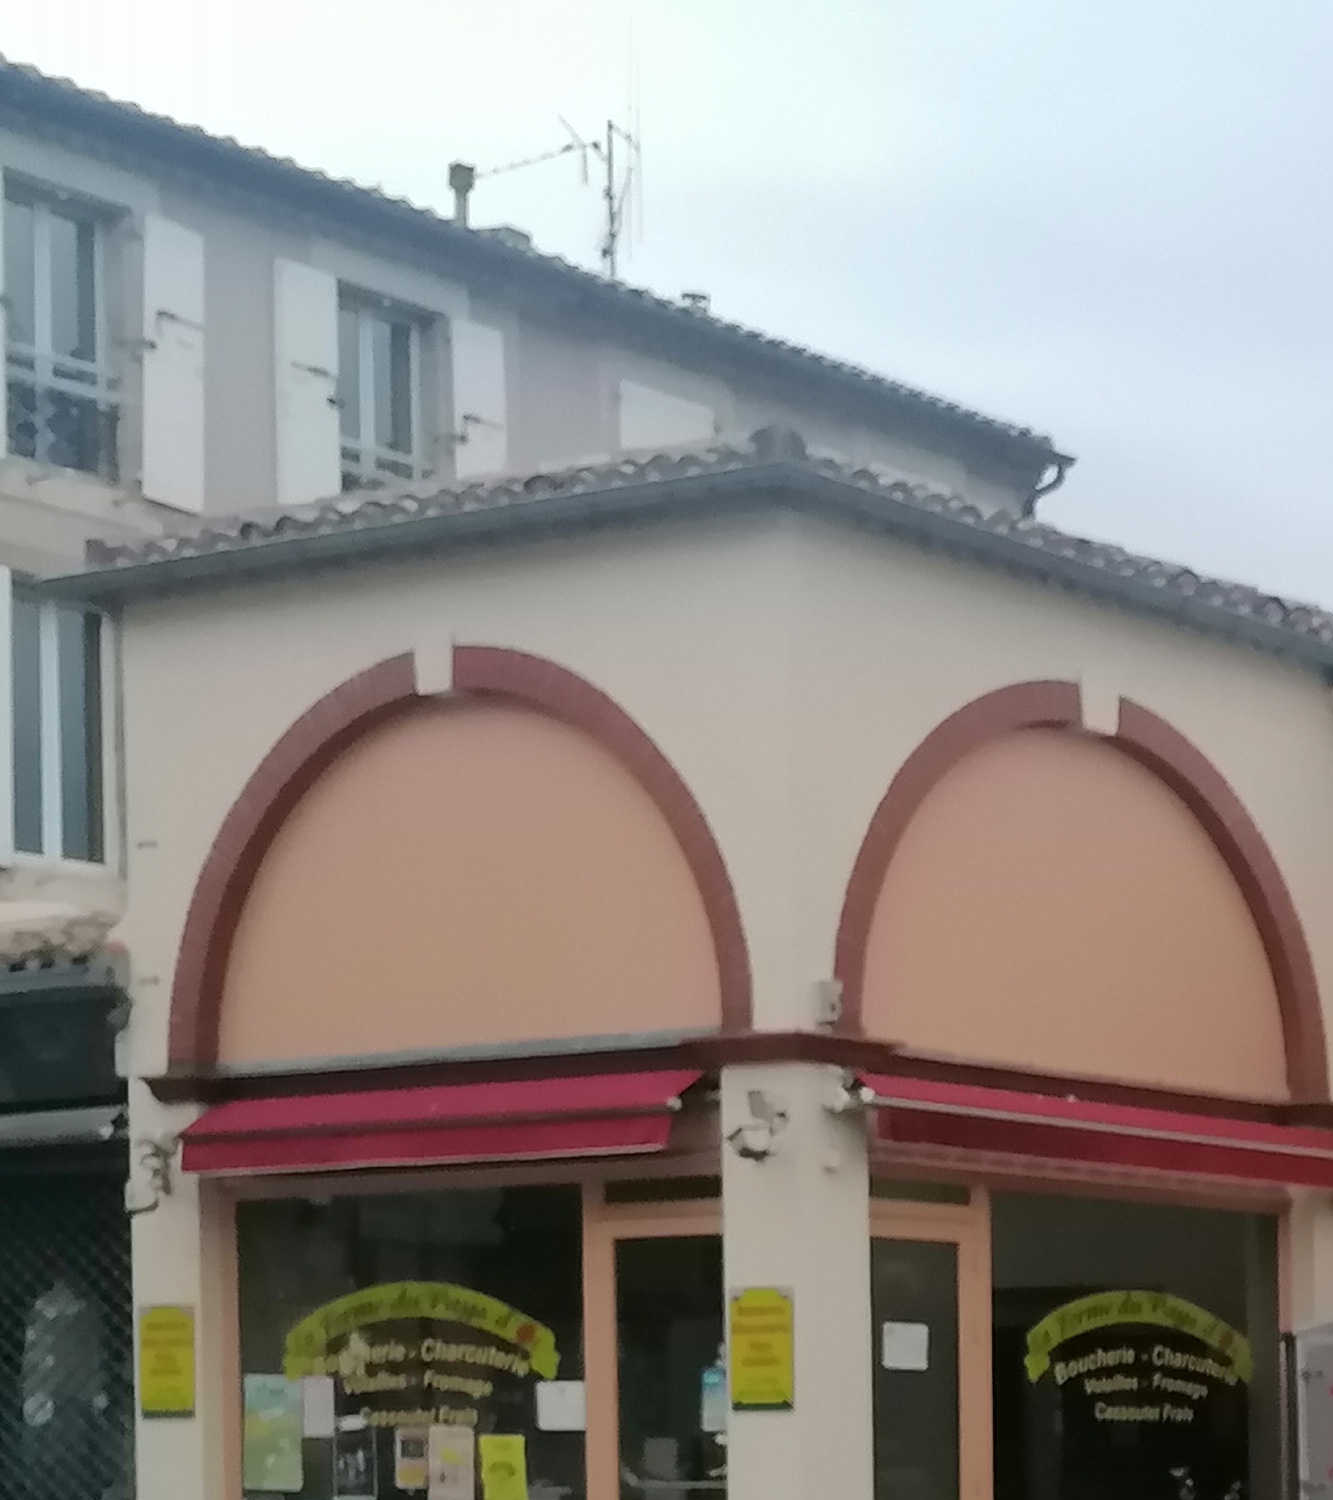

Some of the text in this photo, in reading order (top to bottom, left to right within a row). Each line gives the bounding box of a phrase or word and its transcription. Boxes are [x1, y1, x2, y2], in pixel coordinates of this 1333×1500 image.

[420, 1336, 530, 1379] Charcuterie
[1054, 1343, 1240, 1386] Boucherie Charcuterie
[1152, 1371, 1210, 1401] Fromage
